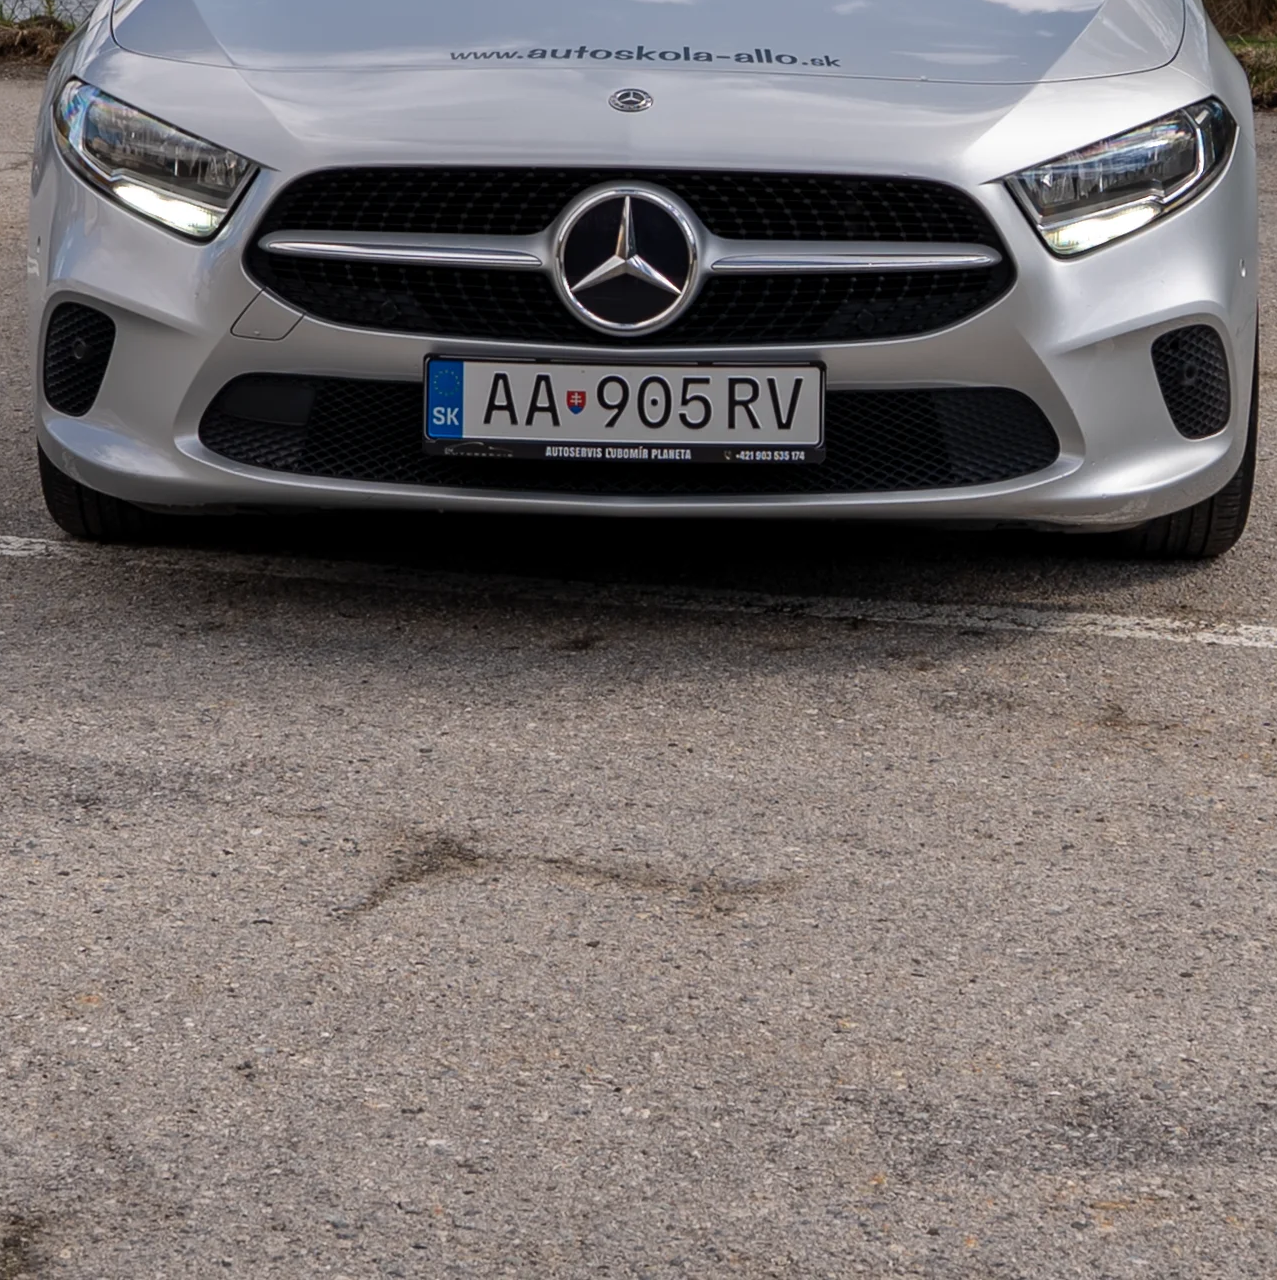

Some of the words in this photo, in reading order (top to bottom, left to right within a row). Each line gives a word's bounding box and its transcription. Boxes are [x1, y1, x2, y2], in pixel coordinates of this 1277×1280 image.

[450, 45, 841, 68] www.autoskola-allo.sk
[482, 372, 562, 427] AA
[432, 406, 460, 427] SK
[545, 446, 603, 458] AUTOSERVIS
[651, 448, 692, 460] PLANETA
[735, 450, 754, 461] +421
[755, 451, 772, 461] 903
[773, 451, 790, 461] 535
[791, 451, 805, 461] 174
